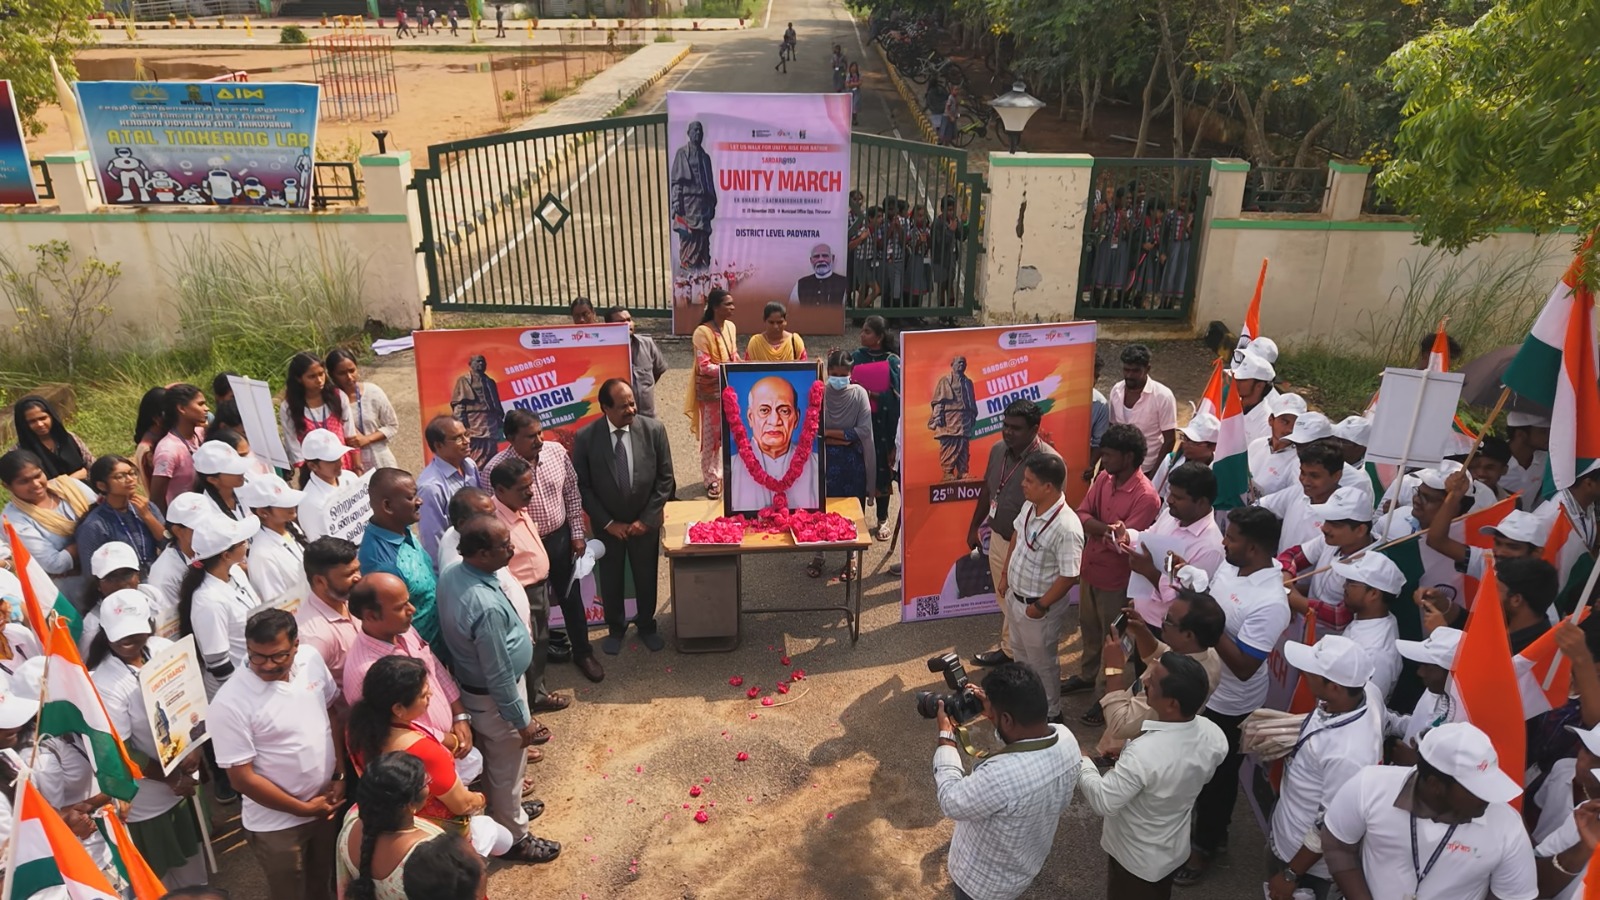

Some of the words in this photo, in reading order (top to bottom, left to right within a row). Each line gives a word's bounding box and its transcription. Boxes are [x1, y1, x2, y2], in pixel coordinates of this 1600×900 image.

[107, 129, 159, 145] ATAL
[165, 130, 269, 147] TINKERING
[275, 132, 310, 148] LAB
[761, 156, 797, 165] SARDAR@150
[719, 169, 774, 192] UNITY
[778, 170, 842, 193] MARCH
[735, 228, 764, 238] DISTRICT
[766, 229, 785, 238] LEVEL
[786, 230, 820, 238] PADYATRA
[504, 355, 556, 375] SARDAR@150
[982, 355, 1029, 375] SARDAR@150
[510, 370, 558, 396] UNITY
[986, 369, 1029, 395] UNITY
[512, 386, 574, 412] MARCH
[551, 412, 575, 425] BHARAT
[932, 486, 955, 502] 25th
[957, 486, 982, 499] Nov
[151, 676, 166, 692] UNITY
